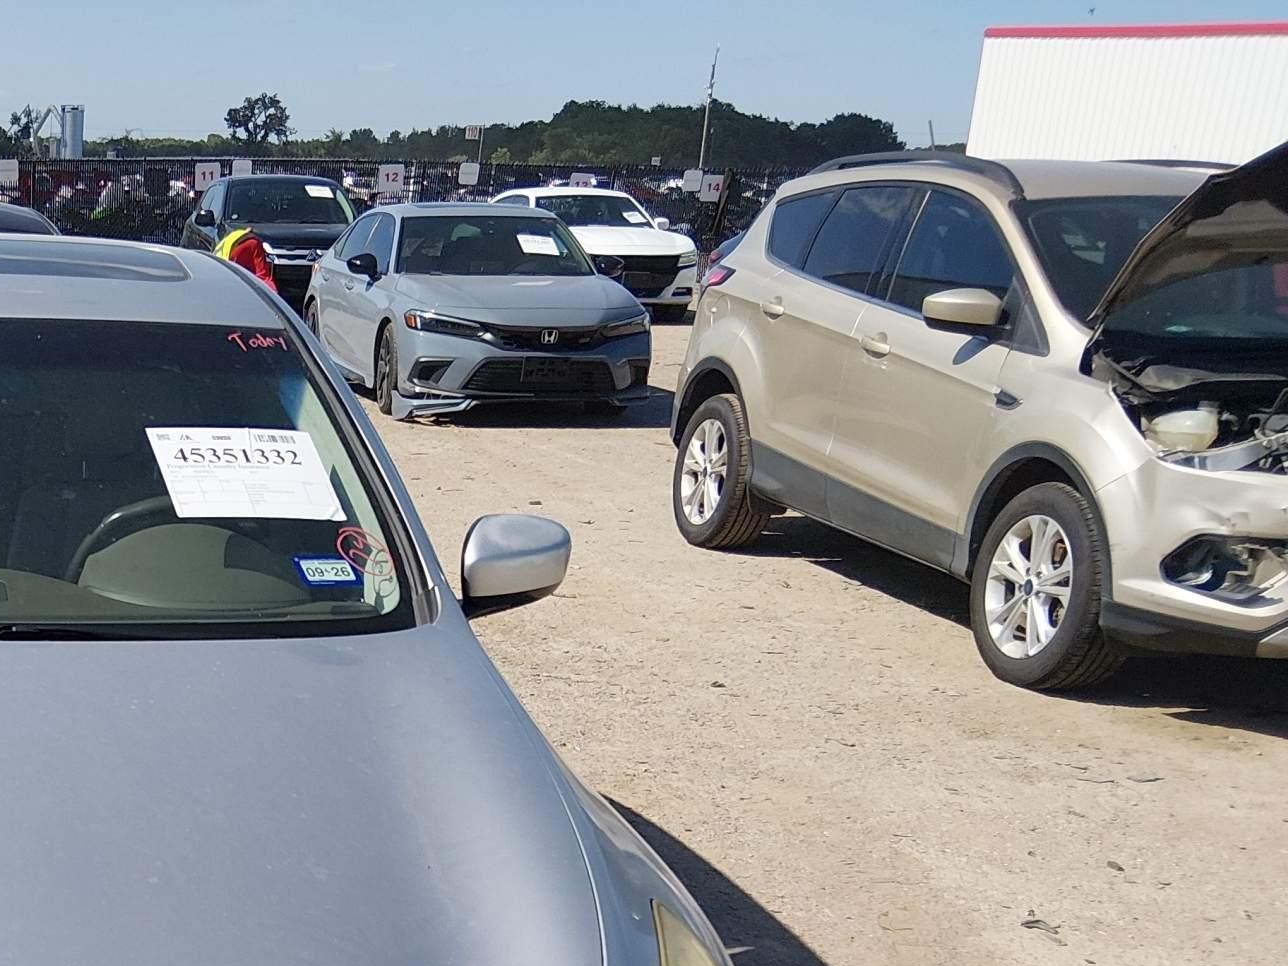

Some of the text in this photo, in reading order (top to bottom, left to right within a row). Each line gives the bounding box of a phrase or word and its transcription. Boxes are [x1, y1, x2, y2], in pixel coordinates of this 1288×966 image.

[201, 171, 214, 181] 11
[384, 172, 399, 183] 12
[708, 183, 721, 193] 14
[228, 333, 287, 352] Today
[174, 448, 302, 466] 45351332
